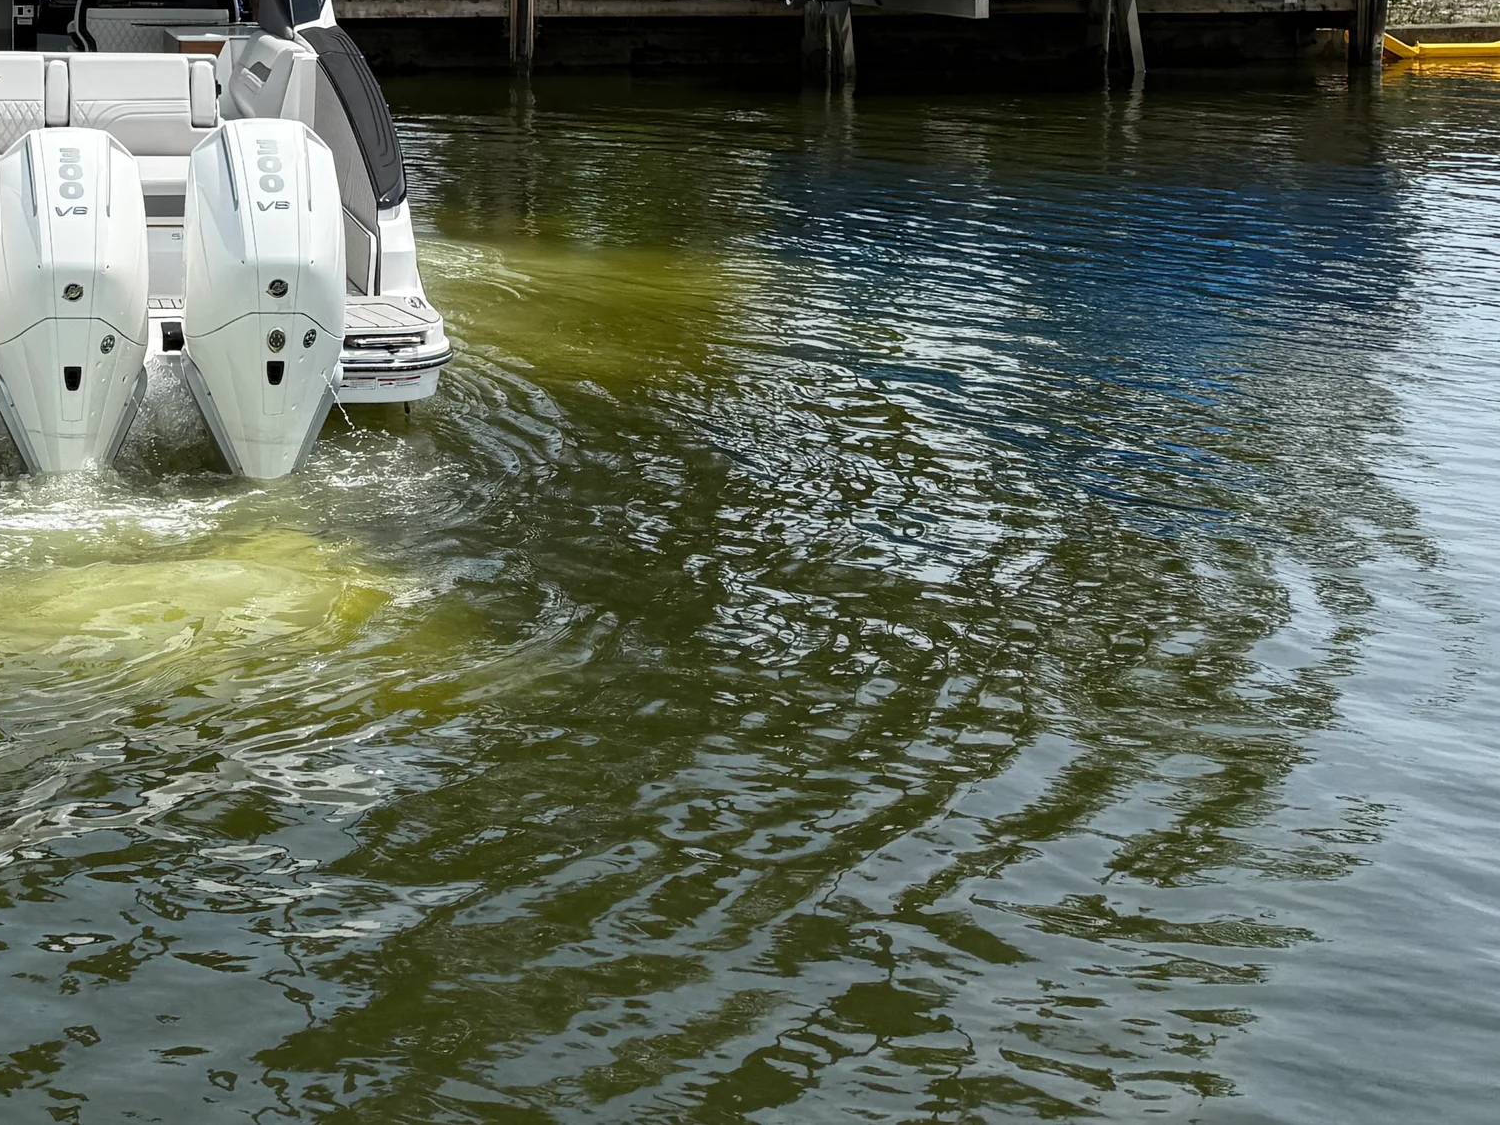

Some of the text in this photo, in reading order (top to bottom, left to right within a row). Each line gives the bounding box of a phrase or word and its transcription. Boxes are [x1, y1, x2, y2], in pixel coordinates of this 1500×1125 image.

[58, 147, 85, 200] 300
[256, 139, 285, 193] 300
[54, 206, 89, 217] V6
[256, 200, 291, 212] V6
